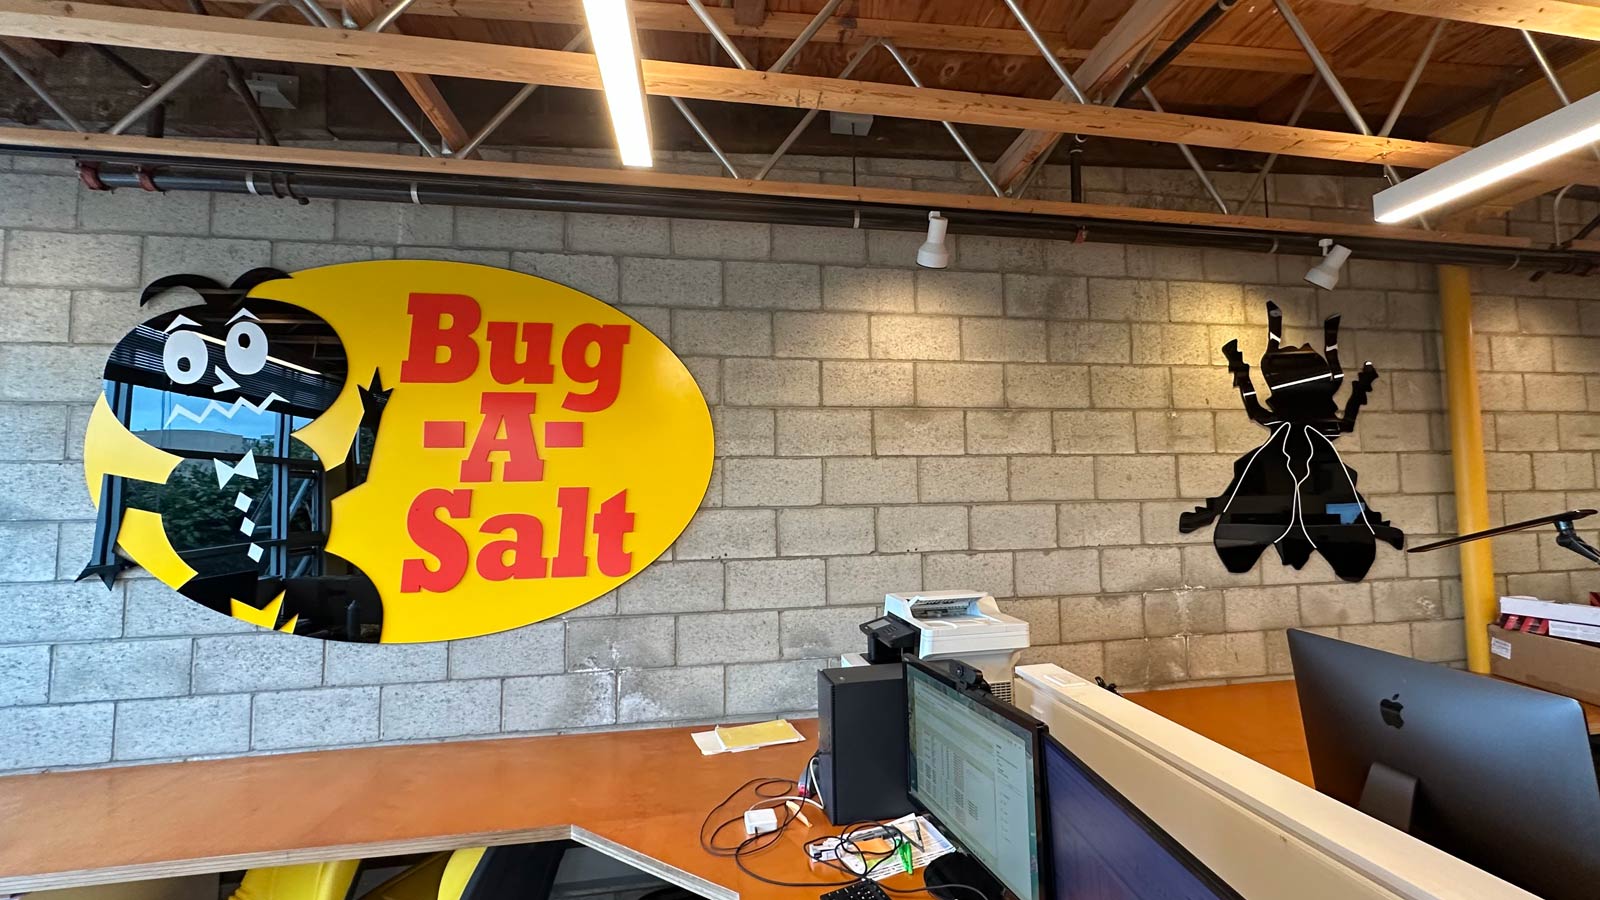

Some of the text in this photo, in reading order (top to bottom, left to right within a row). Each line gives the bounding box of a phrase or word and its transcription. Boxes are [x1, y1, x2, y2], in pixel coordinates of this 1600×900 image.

[400, 292, 631, 413] Bug
[423, 392, 584, 482] -A-
[400, 487, 635, 593] Salt
